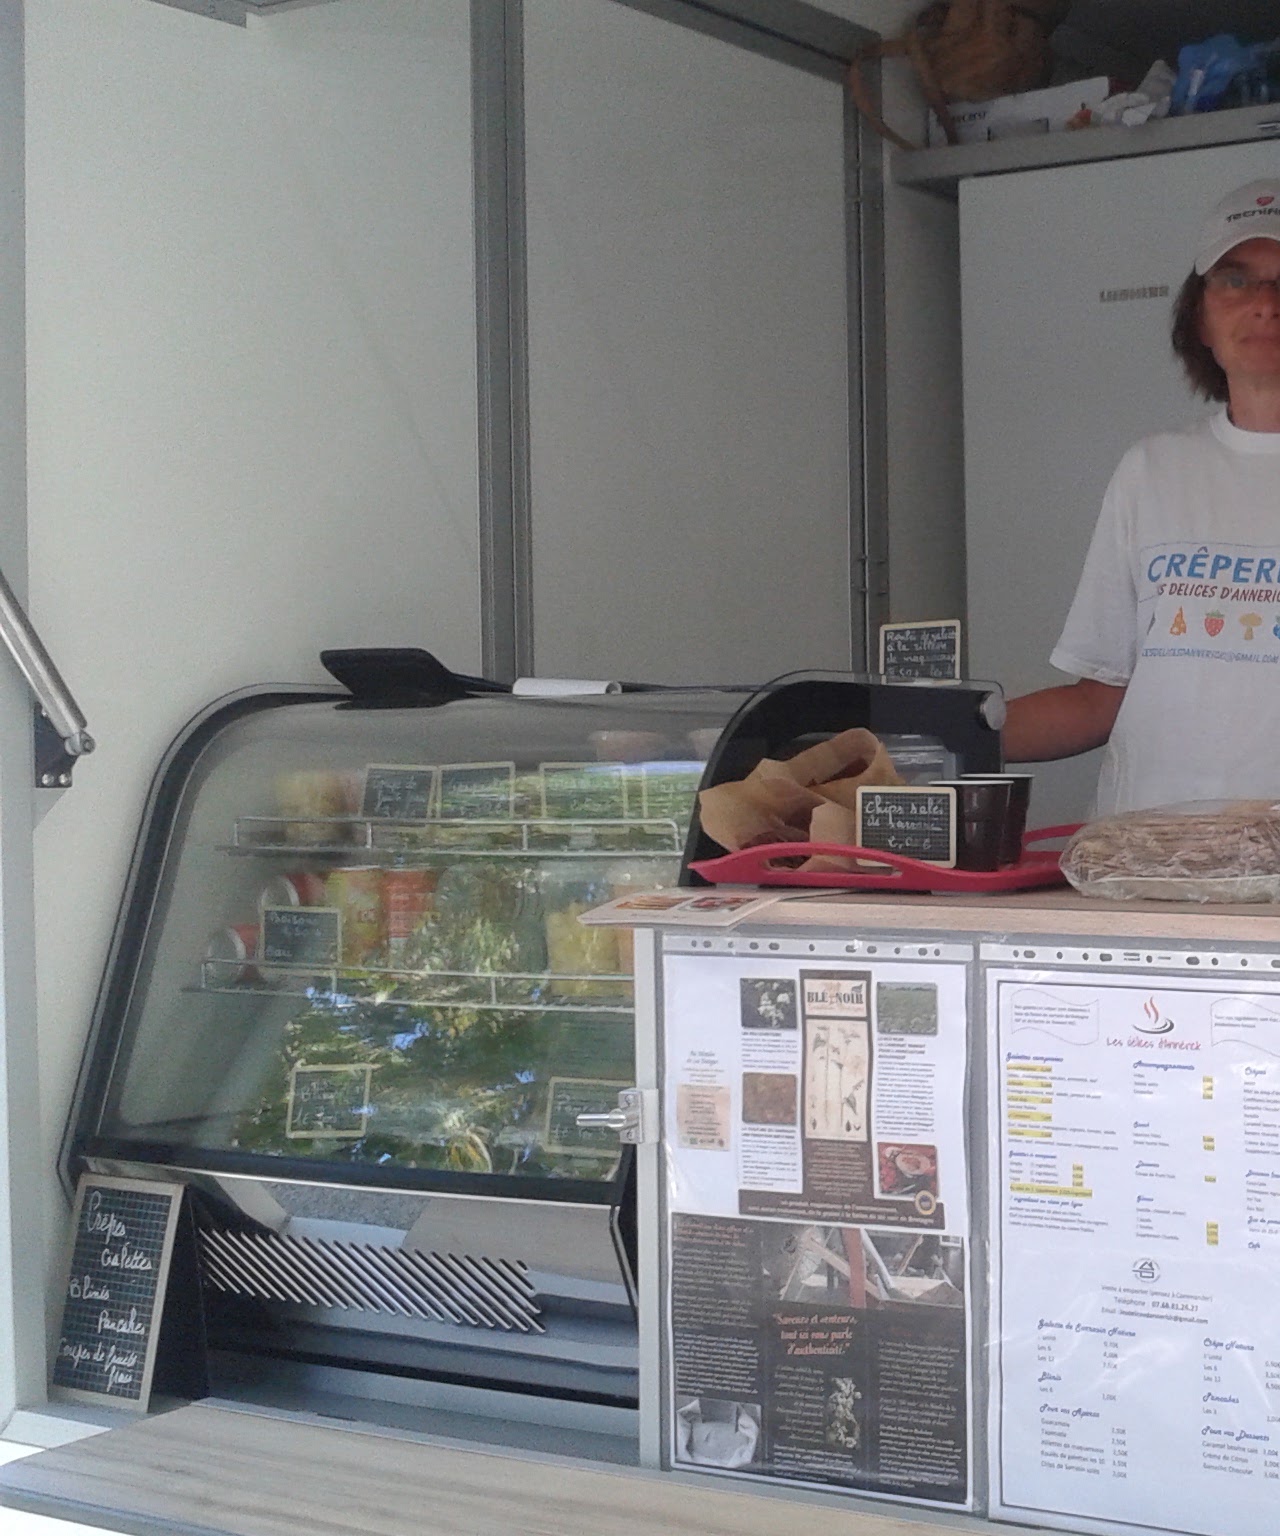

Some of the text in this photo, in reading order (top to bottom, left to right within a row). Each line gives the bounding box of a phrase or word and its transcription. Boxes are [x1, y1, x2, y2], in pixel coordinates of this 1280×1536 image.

[1169, 583, 1218, 599] DELICES
[836, 992, 864, 1004] NOIR
[69, 1275, 110, 1301] Blinis
